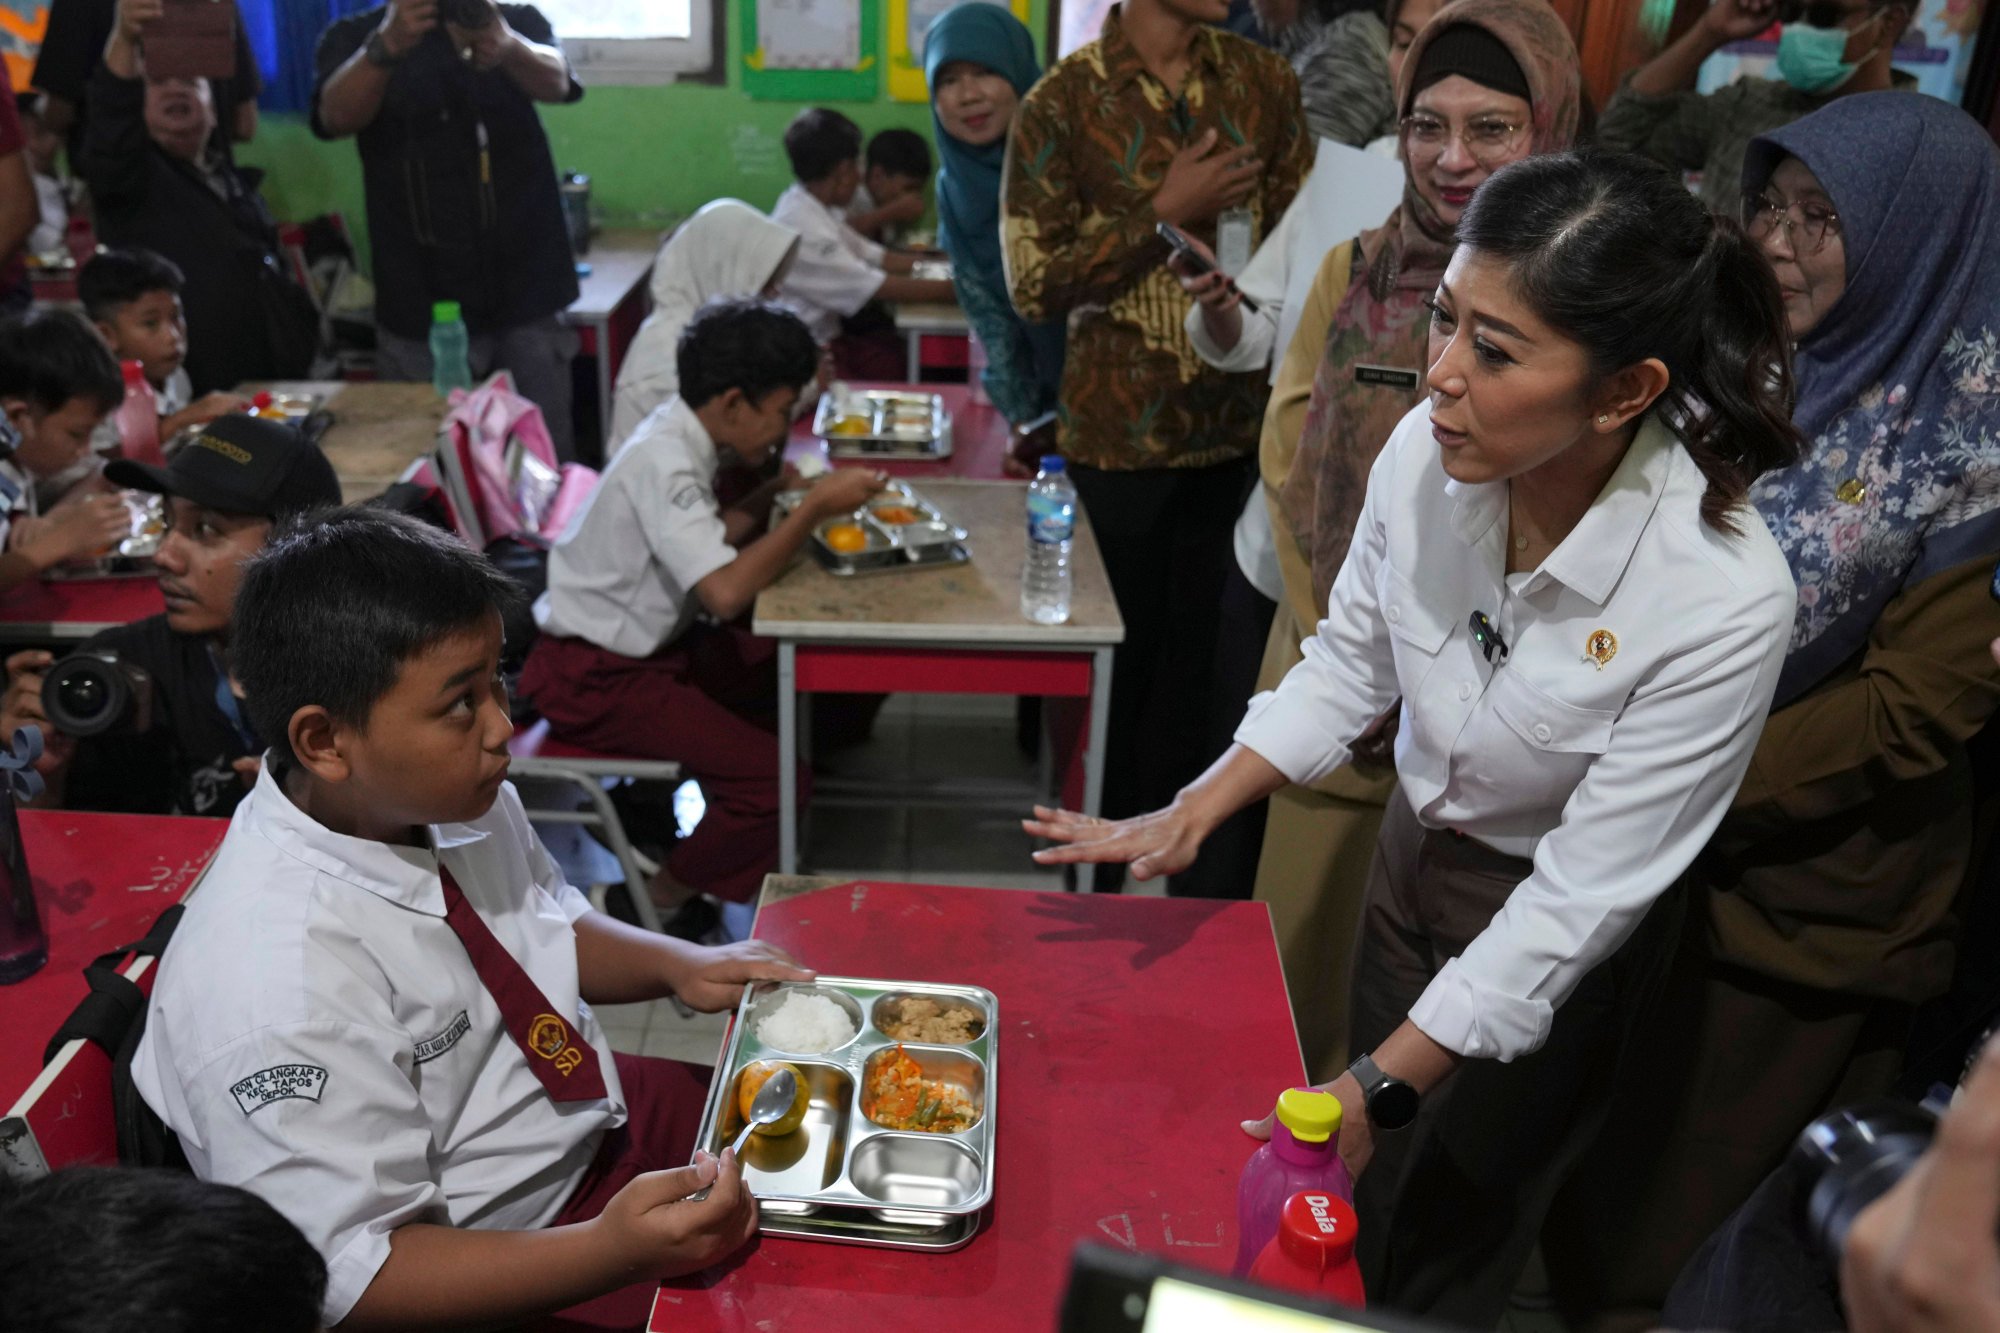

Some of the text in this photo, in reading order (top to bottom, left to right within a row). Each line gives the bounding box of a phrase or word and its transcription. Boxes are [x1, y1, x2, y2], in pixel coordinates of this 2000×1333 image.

[555, 1047, 582, 1077] SD
[235, 1079, 253, 1096] SDN
[254, 1067, 314, 1085] CILANGKAP
[260, 1087, 297, 1102] DEPOK
[272, 1078, 313, 1089] TAPOS
[1304, 1195, 1337, 1234] Daia
